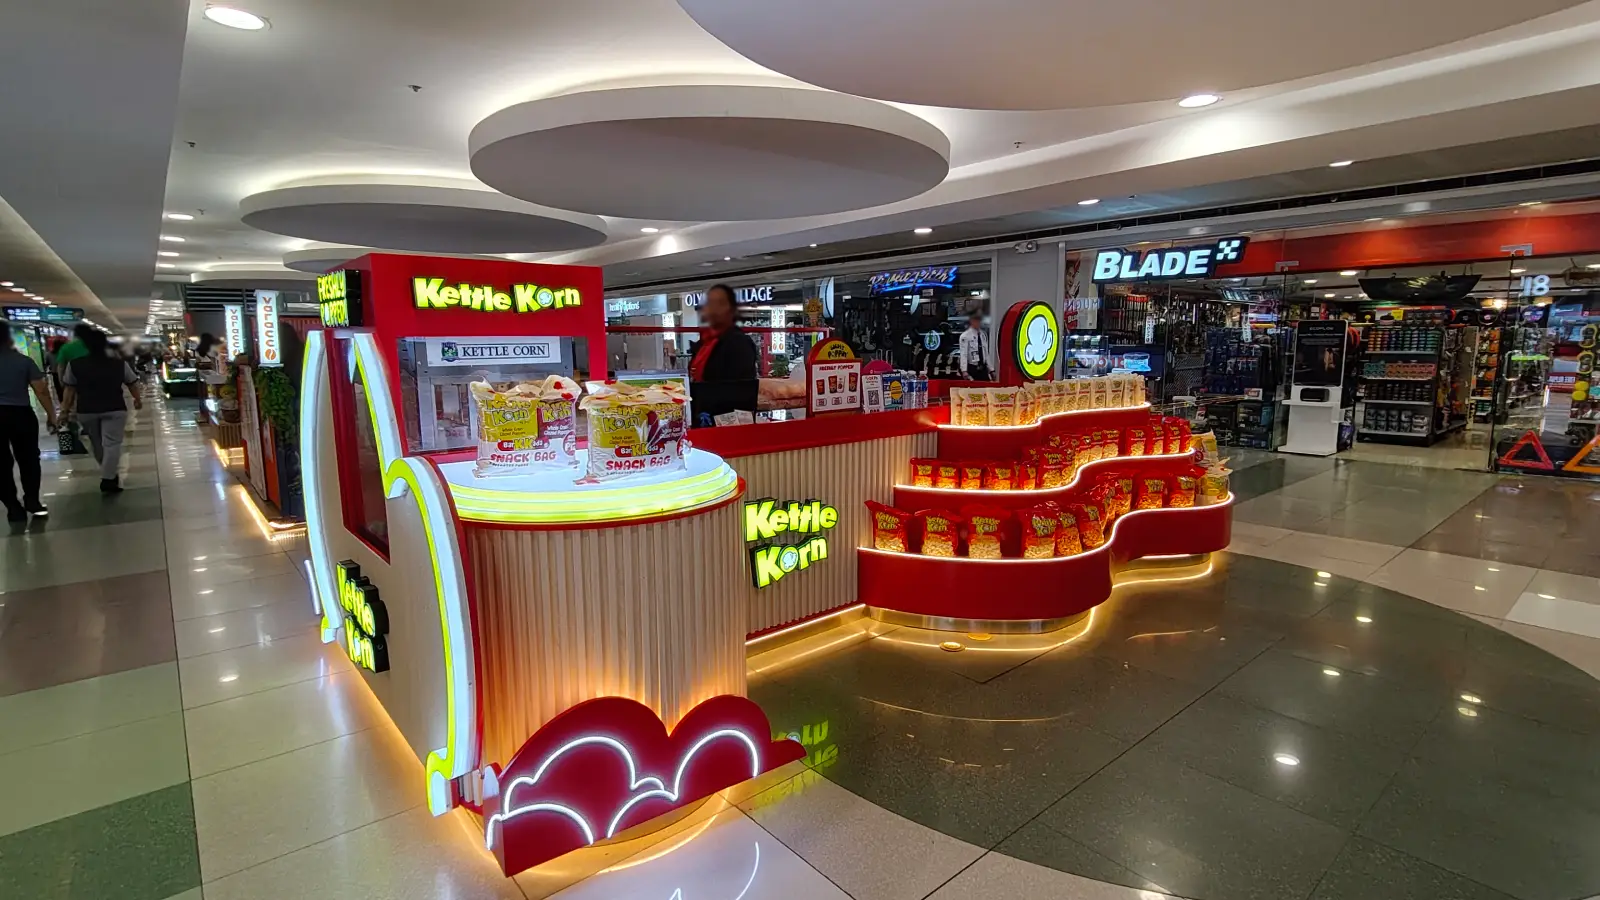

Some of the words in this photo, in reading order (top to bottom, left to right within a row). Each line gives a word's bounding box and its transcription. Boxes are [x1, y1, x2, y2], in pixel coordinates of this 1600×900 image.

[1093, 249, 1212, 280] BLADE
[317, 270, 346, 302] FRESHLY
[735, 286, 773, 303] ILLAGE
[413, 277, 512, 312] Kettle
[513, 282, 582, 314] Korn
[462, 346, 509, 357] KETTLE
[513, 345, 546, 355] CORN
[492, 409, 529, 426] Korn
[603, 416, 640, 432] Korn
[490, 453, 530, 463] SNACK
[534, 450, 557, 462] BAG
[606, 459, 646, 471] SNACK
[650, 455, 671, 467] BAG
[745, 500, 838, 541] Kettle
[755, 537, 828, 588] Korn
